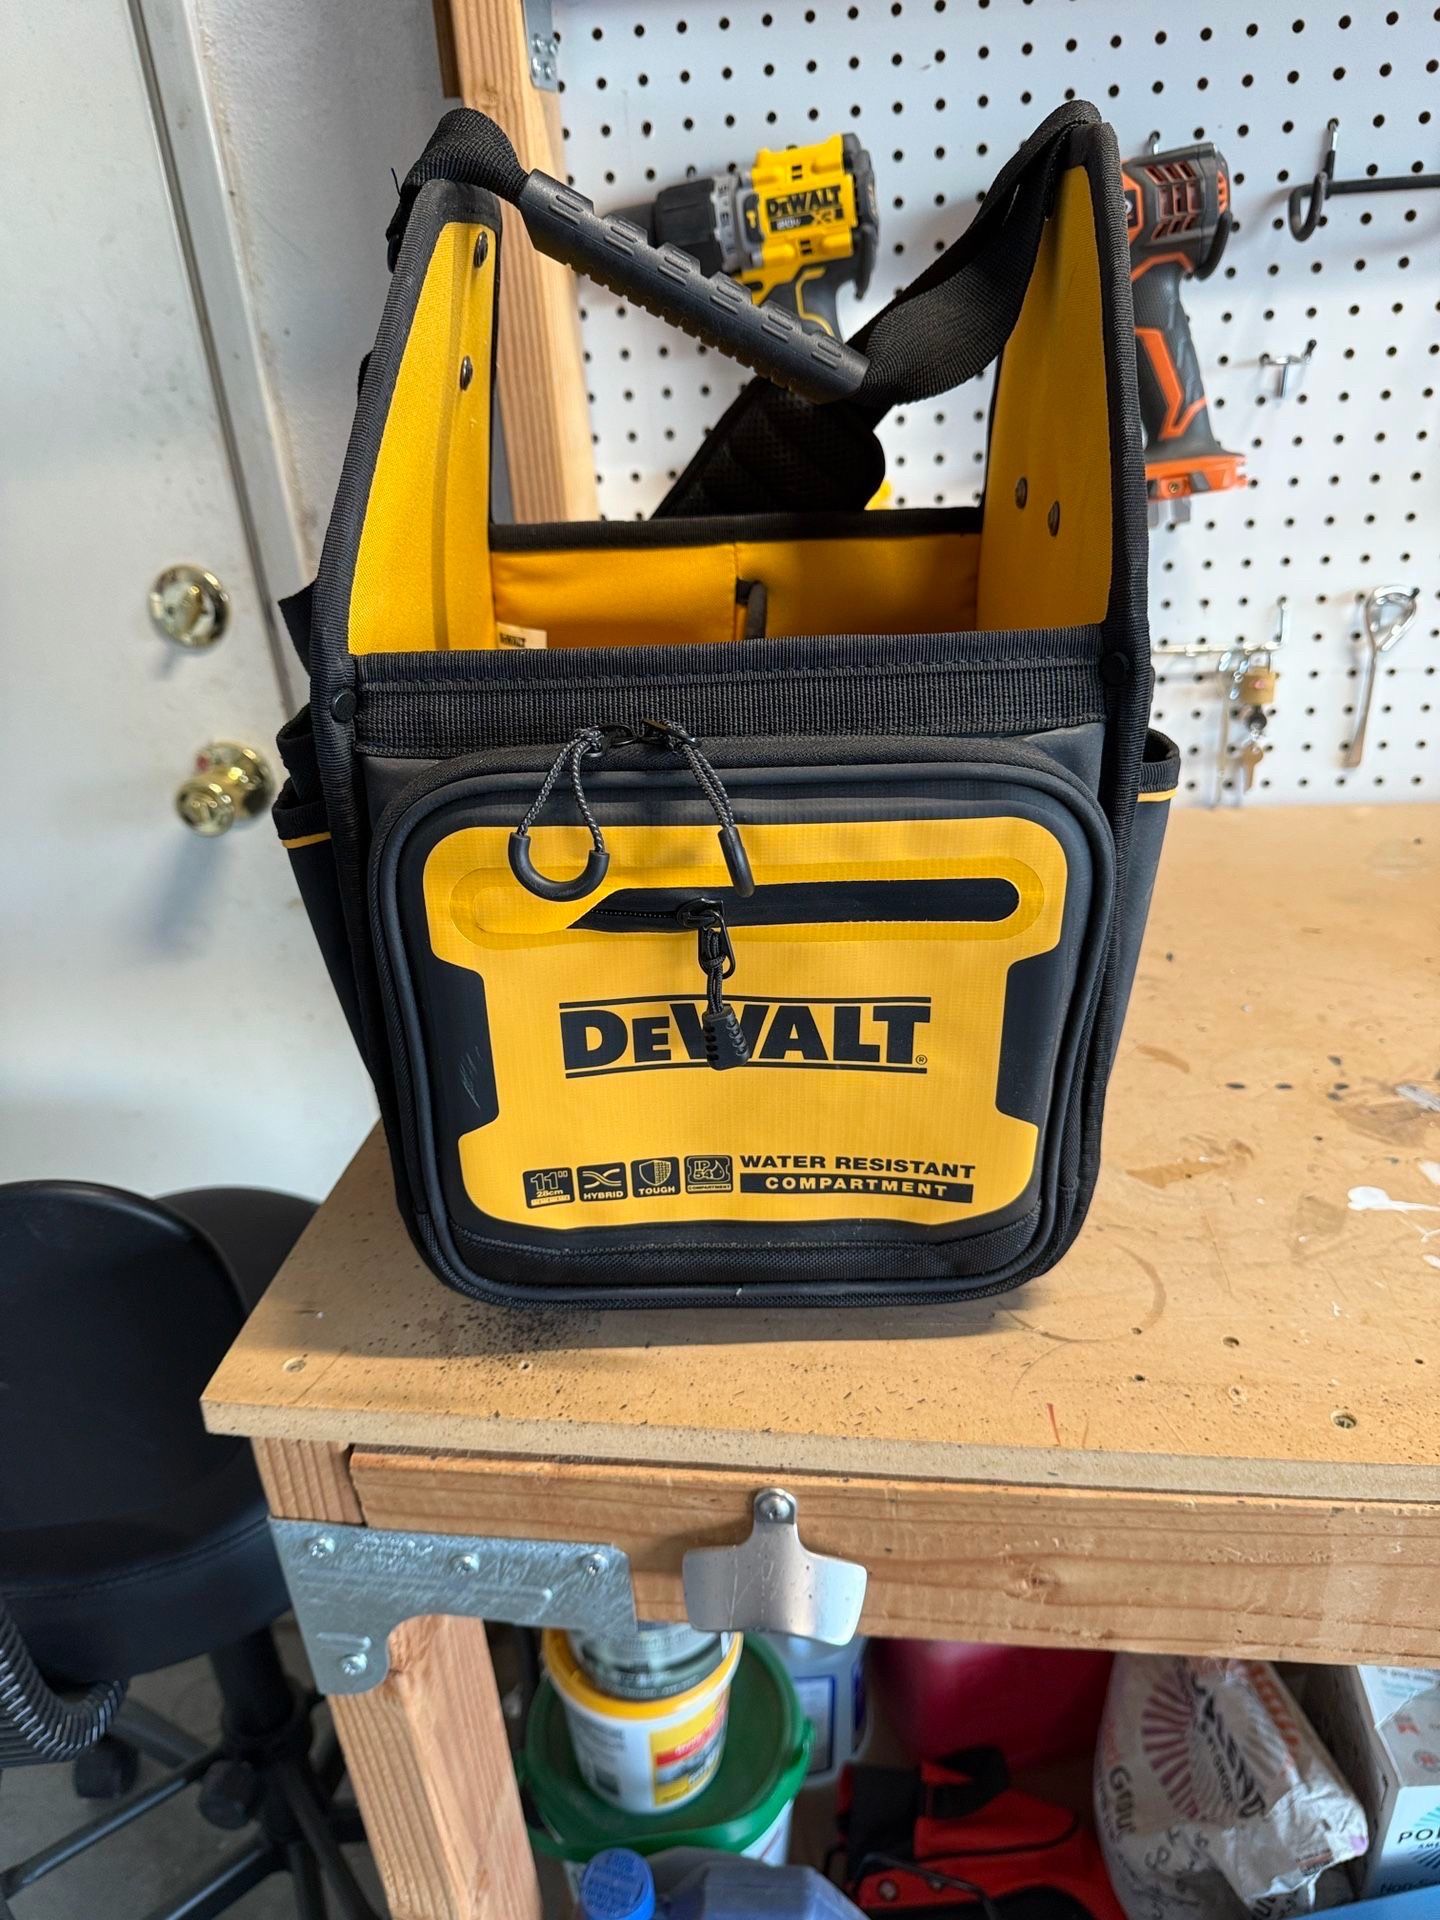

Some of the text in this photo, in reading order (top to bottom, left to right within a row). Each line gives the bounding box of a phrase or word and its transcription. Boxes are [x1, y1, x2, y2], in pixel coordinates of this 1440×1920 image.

[740, 1155, 976, 1179] WATER RESISTANT
[638, 1185, 676, 1196] TOUGH
[765, 1176, 947, 1197] COMPARTMENT
[583, 1190, 624, 1200] HYBRID
